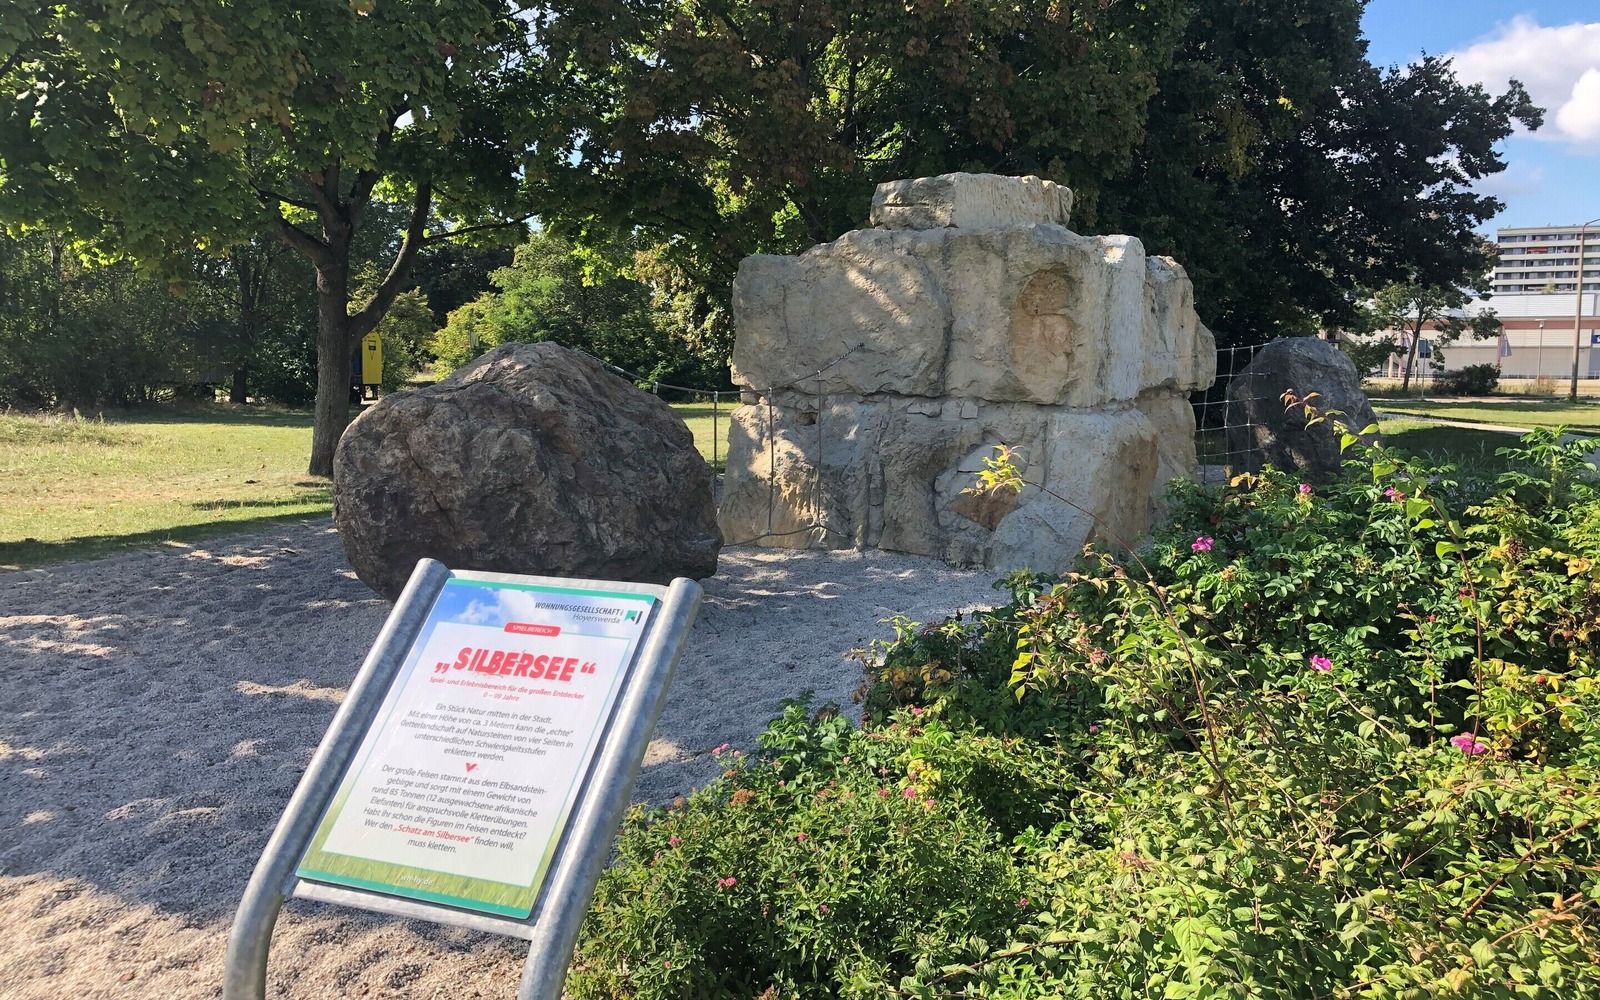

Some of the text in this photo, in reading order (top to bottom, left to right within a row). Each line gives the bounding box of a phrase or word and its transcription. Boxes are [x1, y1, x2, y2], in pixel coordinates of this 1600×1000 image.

[534, 602, 620, 615] WOHNUNGSGESELLSCHAFT
[573, 613, 620, 624] Hoyerswerda
[512, 625, 553, 634] SPIELBEREICH
[429, 677, 447, 685] Spiel-
[460, 680, 507, 691] Erlebnisbereich
[507, 684, 518, 692] für
[528, 687, 551, 696] großen
[552, 690, 585, 700] Entdecker
[408, 710, 421, 718] Mit
[420, 712, 438, 720] einer
[438, 714, 458, 723] Höhe
[489, 721, 514, 730] Metern
[516, 723, 533, 732] kann
[534, 725, 546, 734] die
[435, 702, 552, 724] Ein Stück Natur mitten in der Stadt.
[414, 733, 546, 756] unterschiedlichen Schwierigkeitsstufen
[468, 728, 512, 740] Natursteinen
[542, 738, 565, 747] Seiten
[443, 747, 505, 761] erklettert werden.
[382, 764, 395, 773] Der
[395, 767, 416, 776] große
[417, 770, 439, 779] Felsen
[481, 779, 498, 788] dem
[499, 781, 547, 795] Elbsandstein-
[386, 778, 414, 788] gebirge
[415, 782, 430, 790] und
[430, 785, 449, 794] sorgt
[462, 788, 485, 798] einem
[486, 791, 517, 803] Gewicht
[371, 786, 538, 818] rund 85 Tonnen (12 ausgewachsene afrikanische
[363, 807, 527, 840] Habt ihr schon die Figuren im Felsen entdeckt?
[405, 801, 416, 810] für
[416, 805, 469, 819] anspruchsvolle
[469, 811, 528, 828] Kletterübungen.
[364, 819, 379, 827] Wer
[379, 821, 393, 830] den
[422, 829, 434, 837] am
[474, 836, 498, 848] finden
[500, 842, 514, 851] will,
[407, 839, 456, 853] muss klettern.
